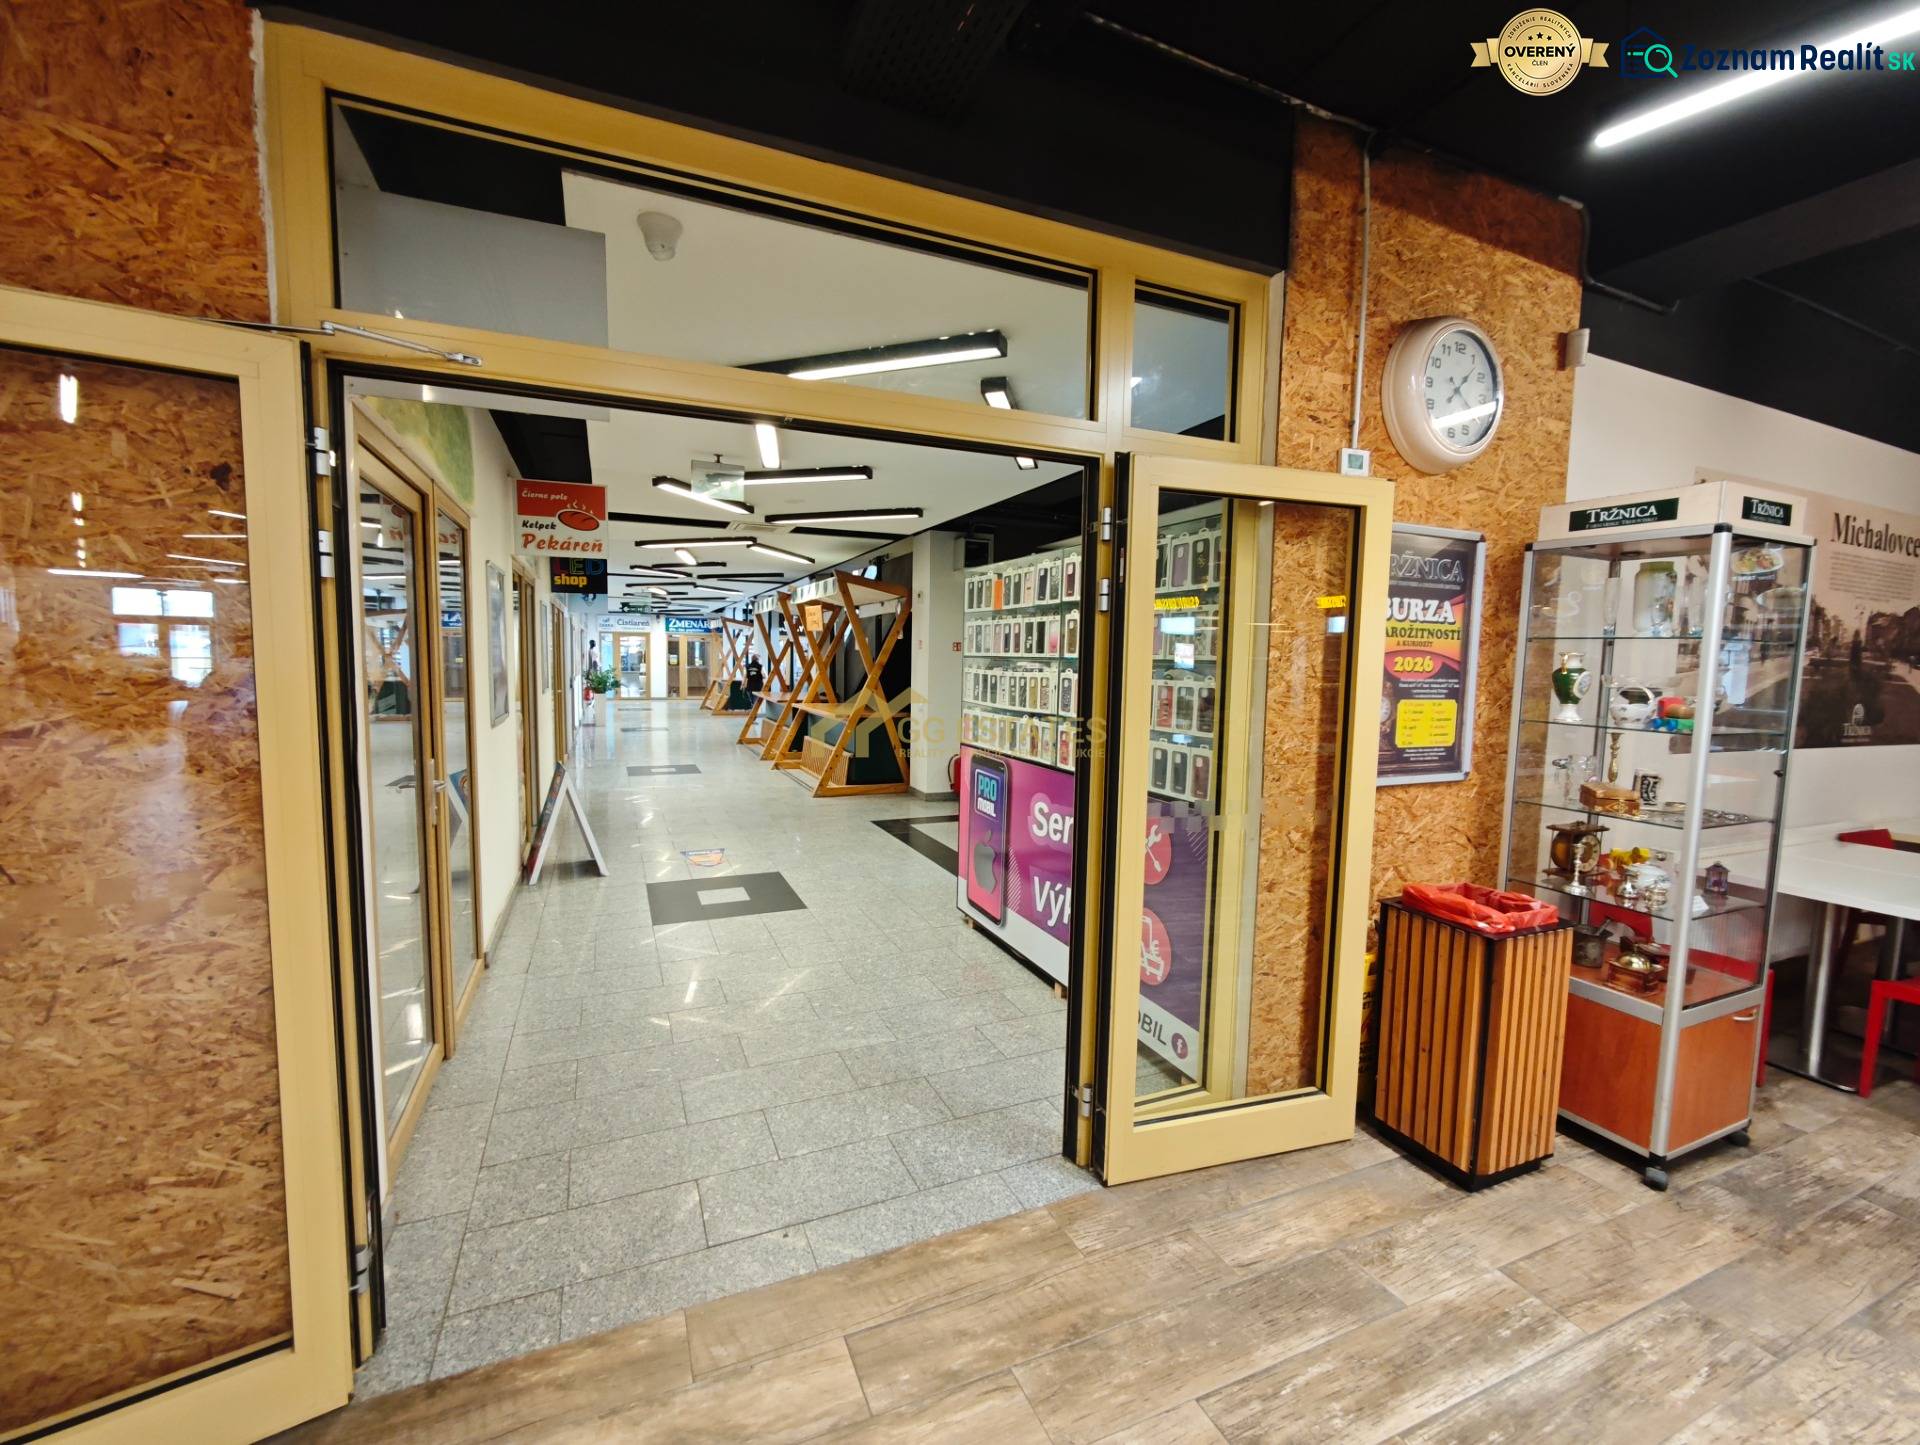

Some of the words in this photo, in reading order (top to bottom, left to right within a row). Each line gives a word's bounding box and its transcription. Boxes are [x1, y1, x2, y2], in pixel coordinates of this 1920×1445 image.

[1454, 341, 1466, 355] 12
[1431, 356, 1442, 369] 10
[1477, 372, 1485, 384] 2
[522, 489, 548, 499] Čierne
[550, 493, 568, 501] pole
[1587, 505, 1658, 523] TRŽNICA
[522, 520, 557, 531] Kelpek
[1830, 512, 1920, 557] Michalovce
[522, 533, 603, 552] Pekáreň
[1390, 550, 1464, 582] RŽNICA
[554, 574, 587, 587] shop
[1394, 656, 1433, 672] 2026
[978, 774, 997, 801] PRO
[1032, 801, 1074, 844] Ser
[1033, 876, 1071, 927] Vý
[1138, 1009, 1167, 1046] BIL
